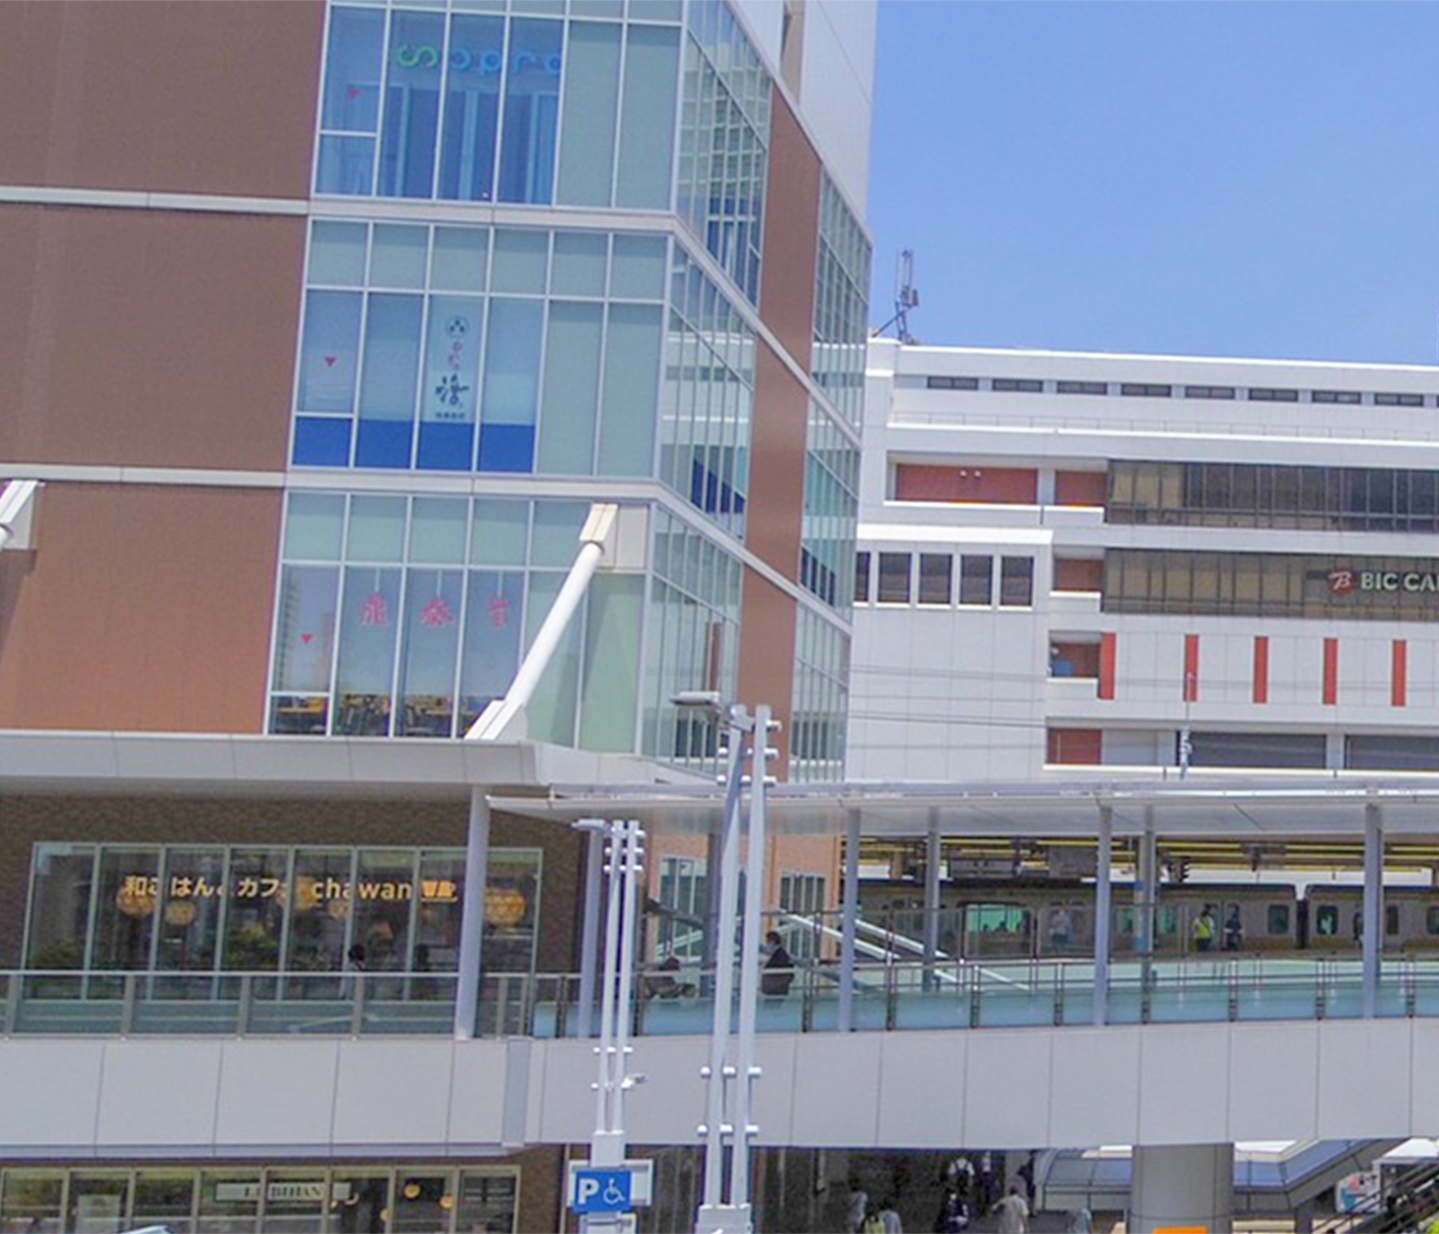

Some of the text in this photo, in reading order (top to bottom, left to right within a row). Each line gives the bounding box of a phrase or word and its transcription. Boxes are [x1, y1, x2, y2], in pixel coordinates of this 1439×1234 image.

[1361, 571, 1398, 591] BIC
[311, 877, 413, 899] chawan
[578, 1178, 600, 1205] P
